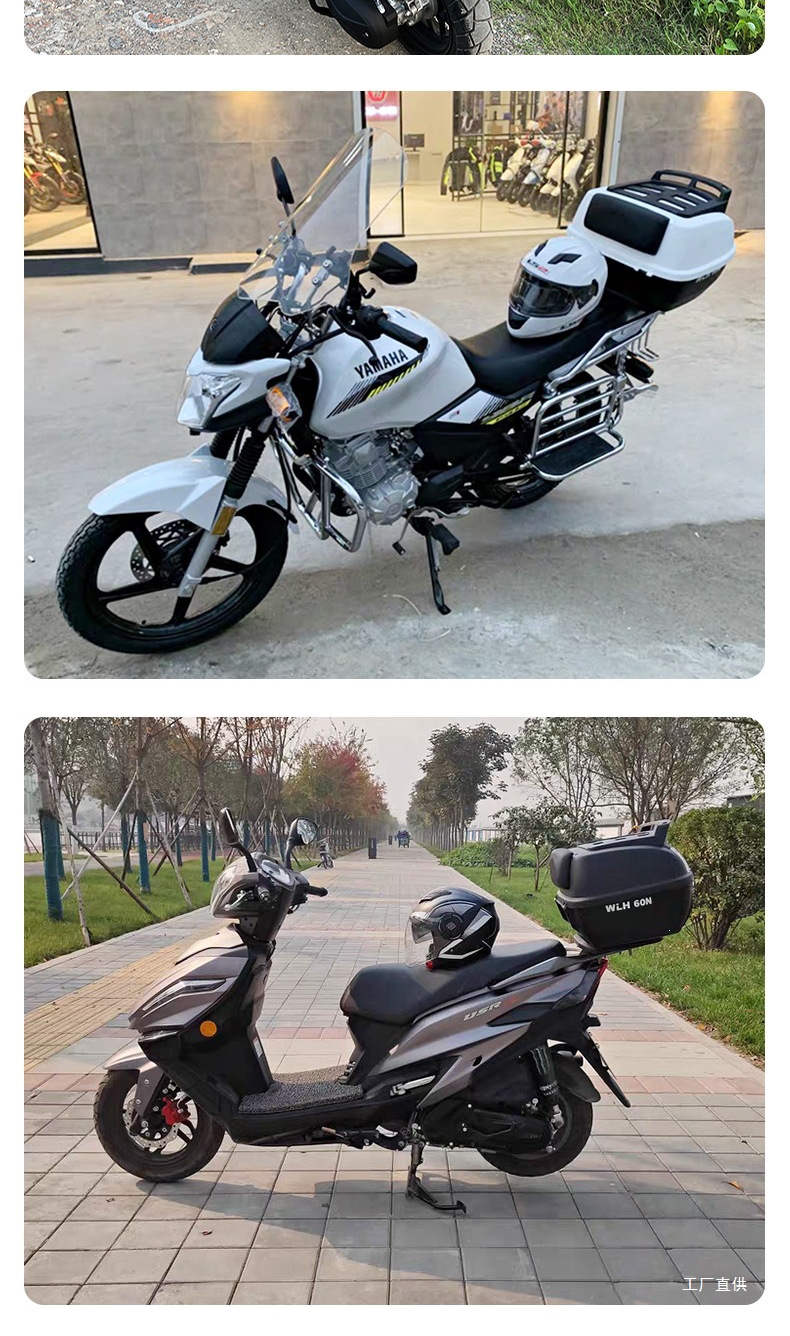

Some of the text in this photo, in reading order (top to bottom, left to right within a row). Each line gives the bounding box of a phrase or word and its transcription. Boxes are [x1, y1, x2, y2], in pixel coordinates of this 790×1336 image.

[354, 348, 409, 379] YAMAHA
[605, 896, 652, 913] WLH 60N
